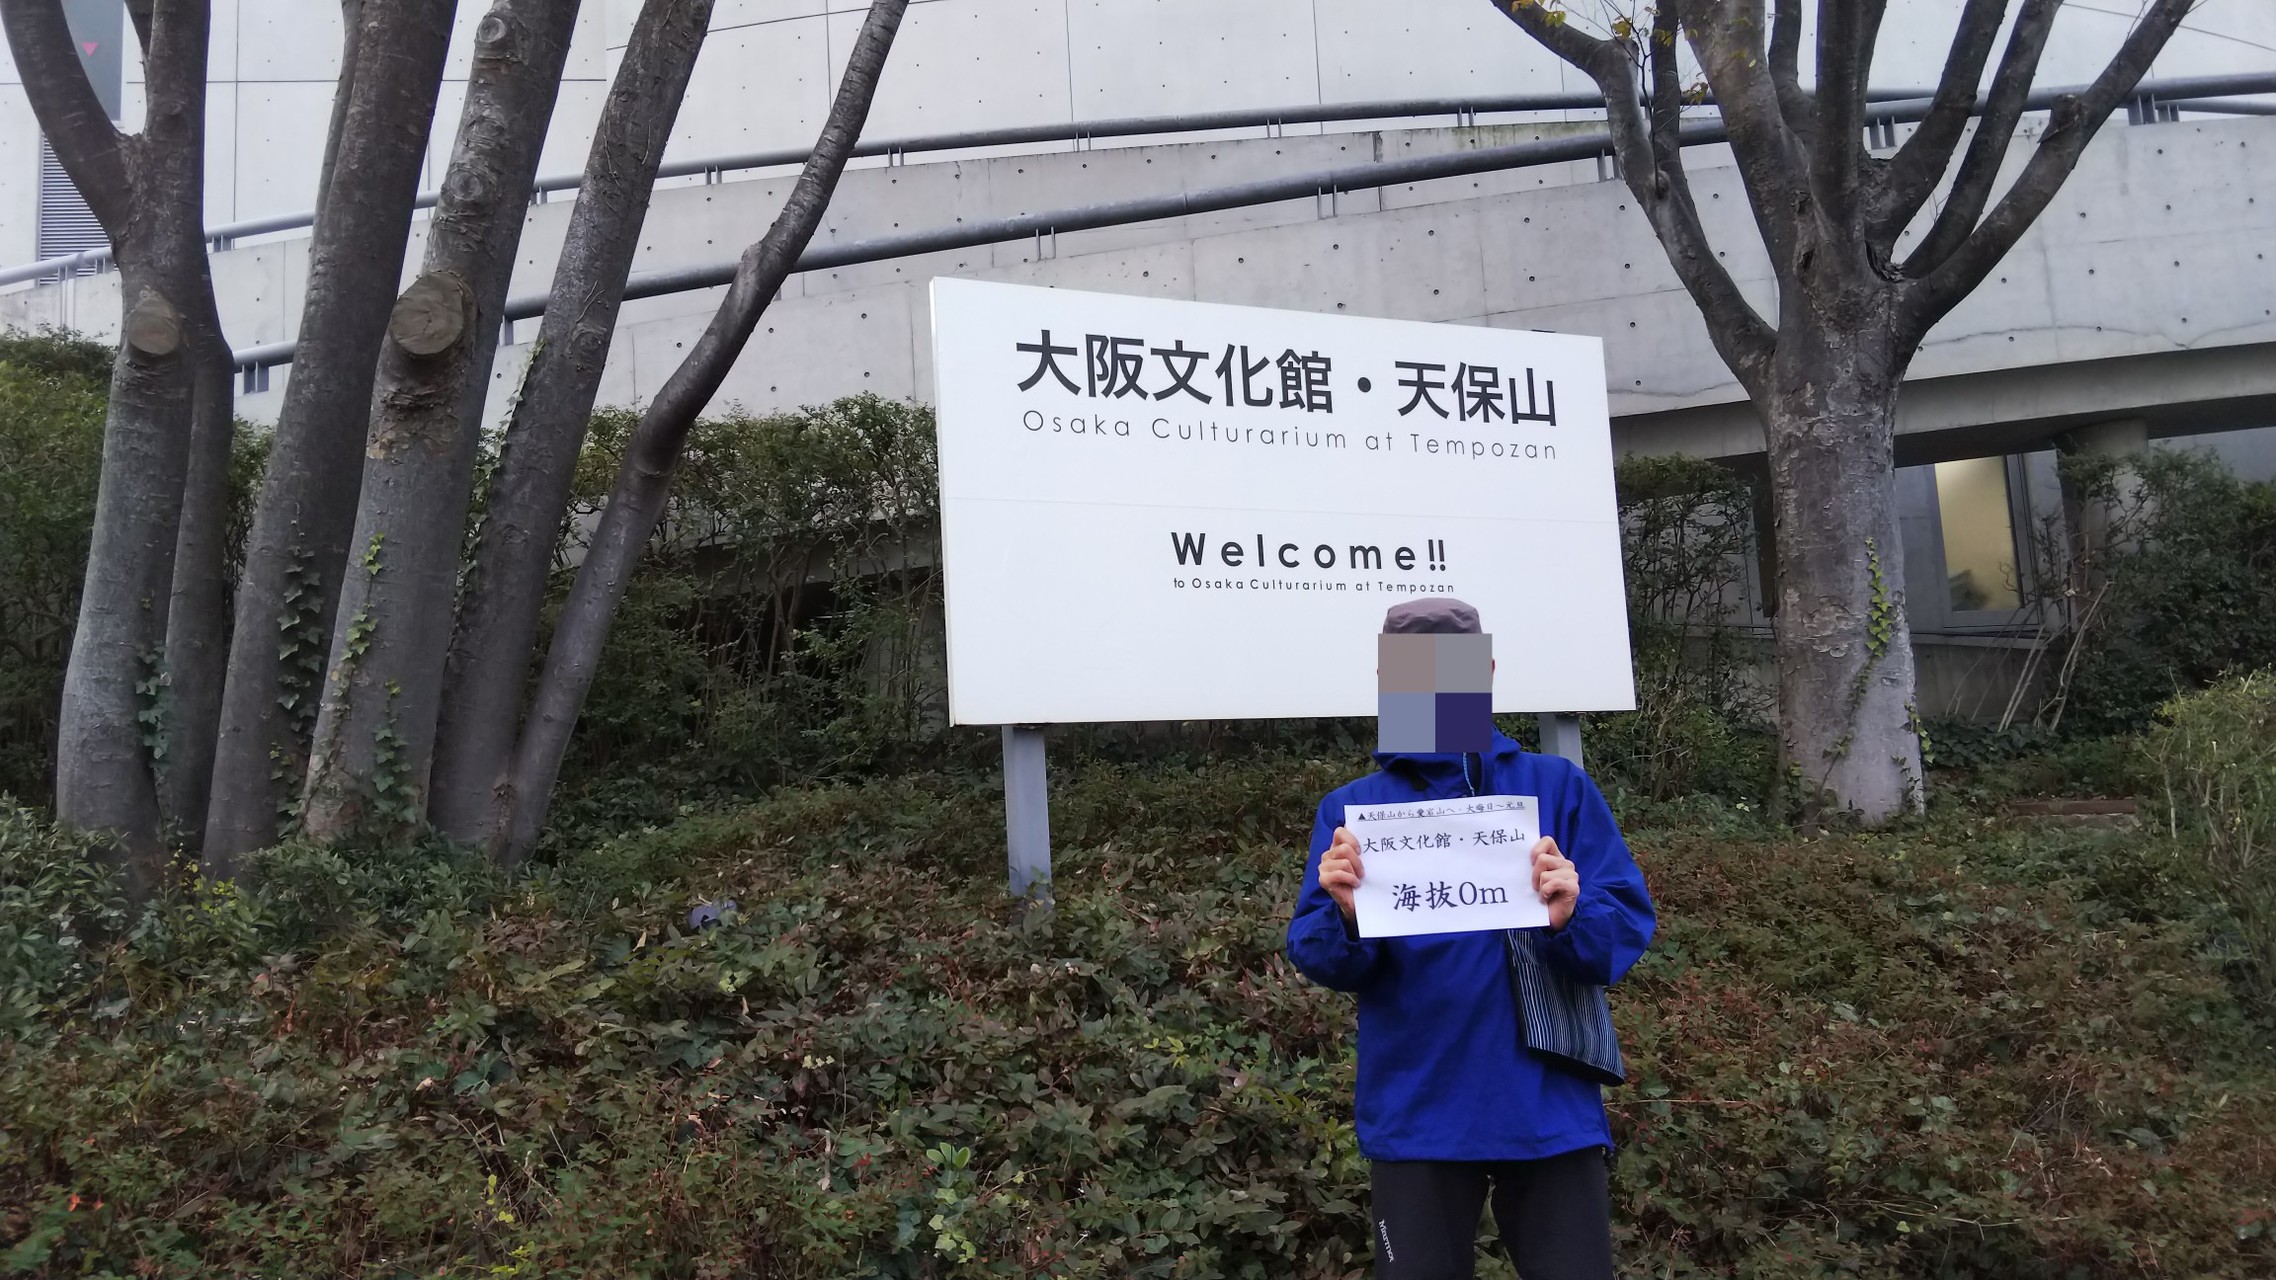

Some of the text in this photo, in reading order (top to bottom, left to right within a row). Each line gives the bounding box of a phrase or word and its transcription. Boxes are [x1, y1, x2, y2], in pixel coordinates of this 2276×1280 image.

[1016, 329, 1557, 426] 大阪文化館・天保山
[1022, 409, 1556, 461] Osaka Culturarium at Tempozan
[1171, 531, 1447, 572] Welcome!!
[1173, 577, 1454, 595] to Osaka Culturarium at Tempozan
[1363, 828, 1526, 854] 大阪文化館・天保山
[1391, 880, 1509, 912] 海抜0m
